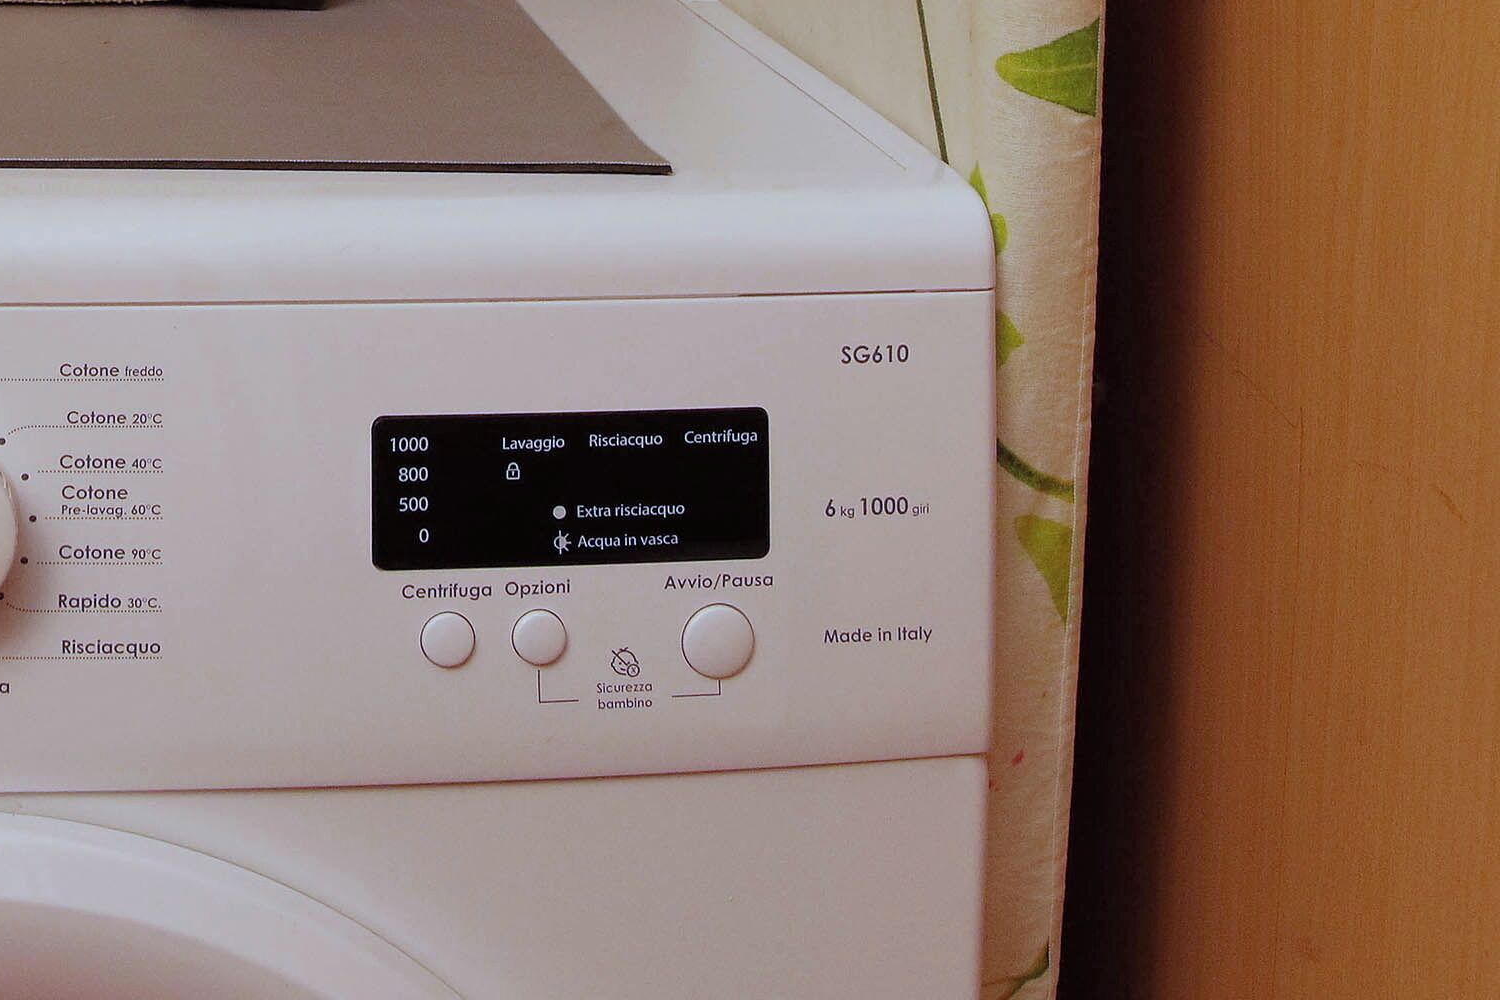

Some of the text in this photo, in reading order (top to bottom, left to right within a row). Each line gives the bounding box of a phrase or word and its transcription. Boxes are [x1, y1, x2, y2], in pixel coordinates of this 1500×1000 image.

[840, 344, 909, 365] SG610
[59, 363, 163, 377] Cotone freddo
[66, 410, 163, 427] Cotone 20°C
[390, 436, 429, 453] 1000
[502, 428, 758, 452] Lavaggio Risciacquo Centrifuga
[59, 454, 162, 470] Cotone 40°C
[398, 466, 429, 483] 800
[61, 484, 129, 500] Cotone
[61, 503, 161, 518] Pre-lavag. 60°C
[399, 496, 429, 512] 500
[576, 503, 685, 519] Extra risciacquo
[825, 496, 930, 519] 6 kg 1000 giri
[418, 528, 430, 543] 0
[577, 533, 679, 551] Acqua in vasca
[58, 544, 162, 560] Cotone 90°C
[401, 578, 571, 601] Centrifuga Opzioni
[664, 573, 774, 591] Avvio/Pausa
[57, 593, 124, 613] Rapido
[823, 625, 933, 644] Made in Italy
[62, 639, 161, 657] Risciacquo
[596, 682, 653, 694] Sicurezza
[597, 697, 653, 710] bambino
